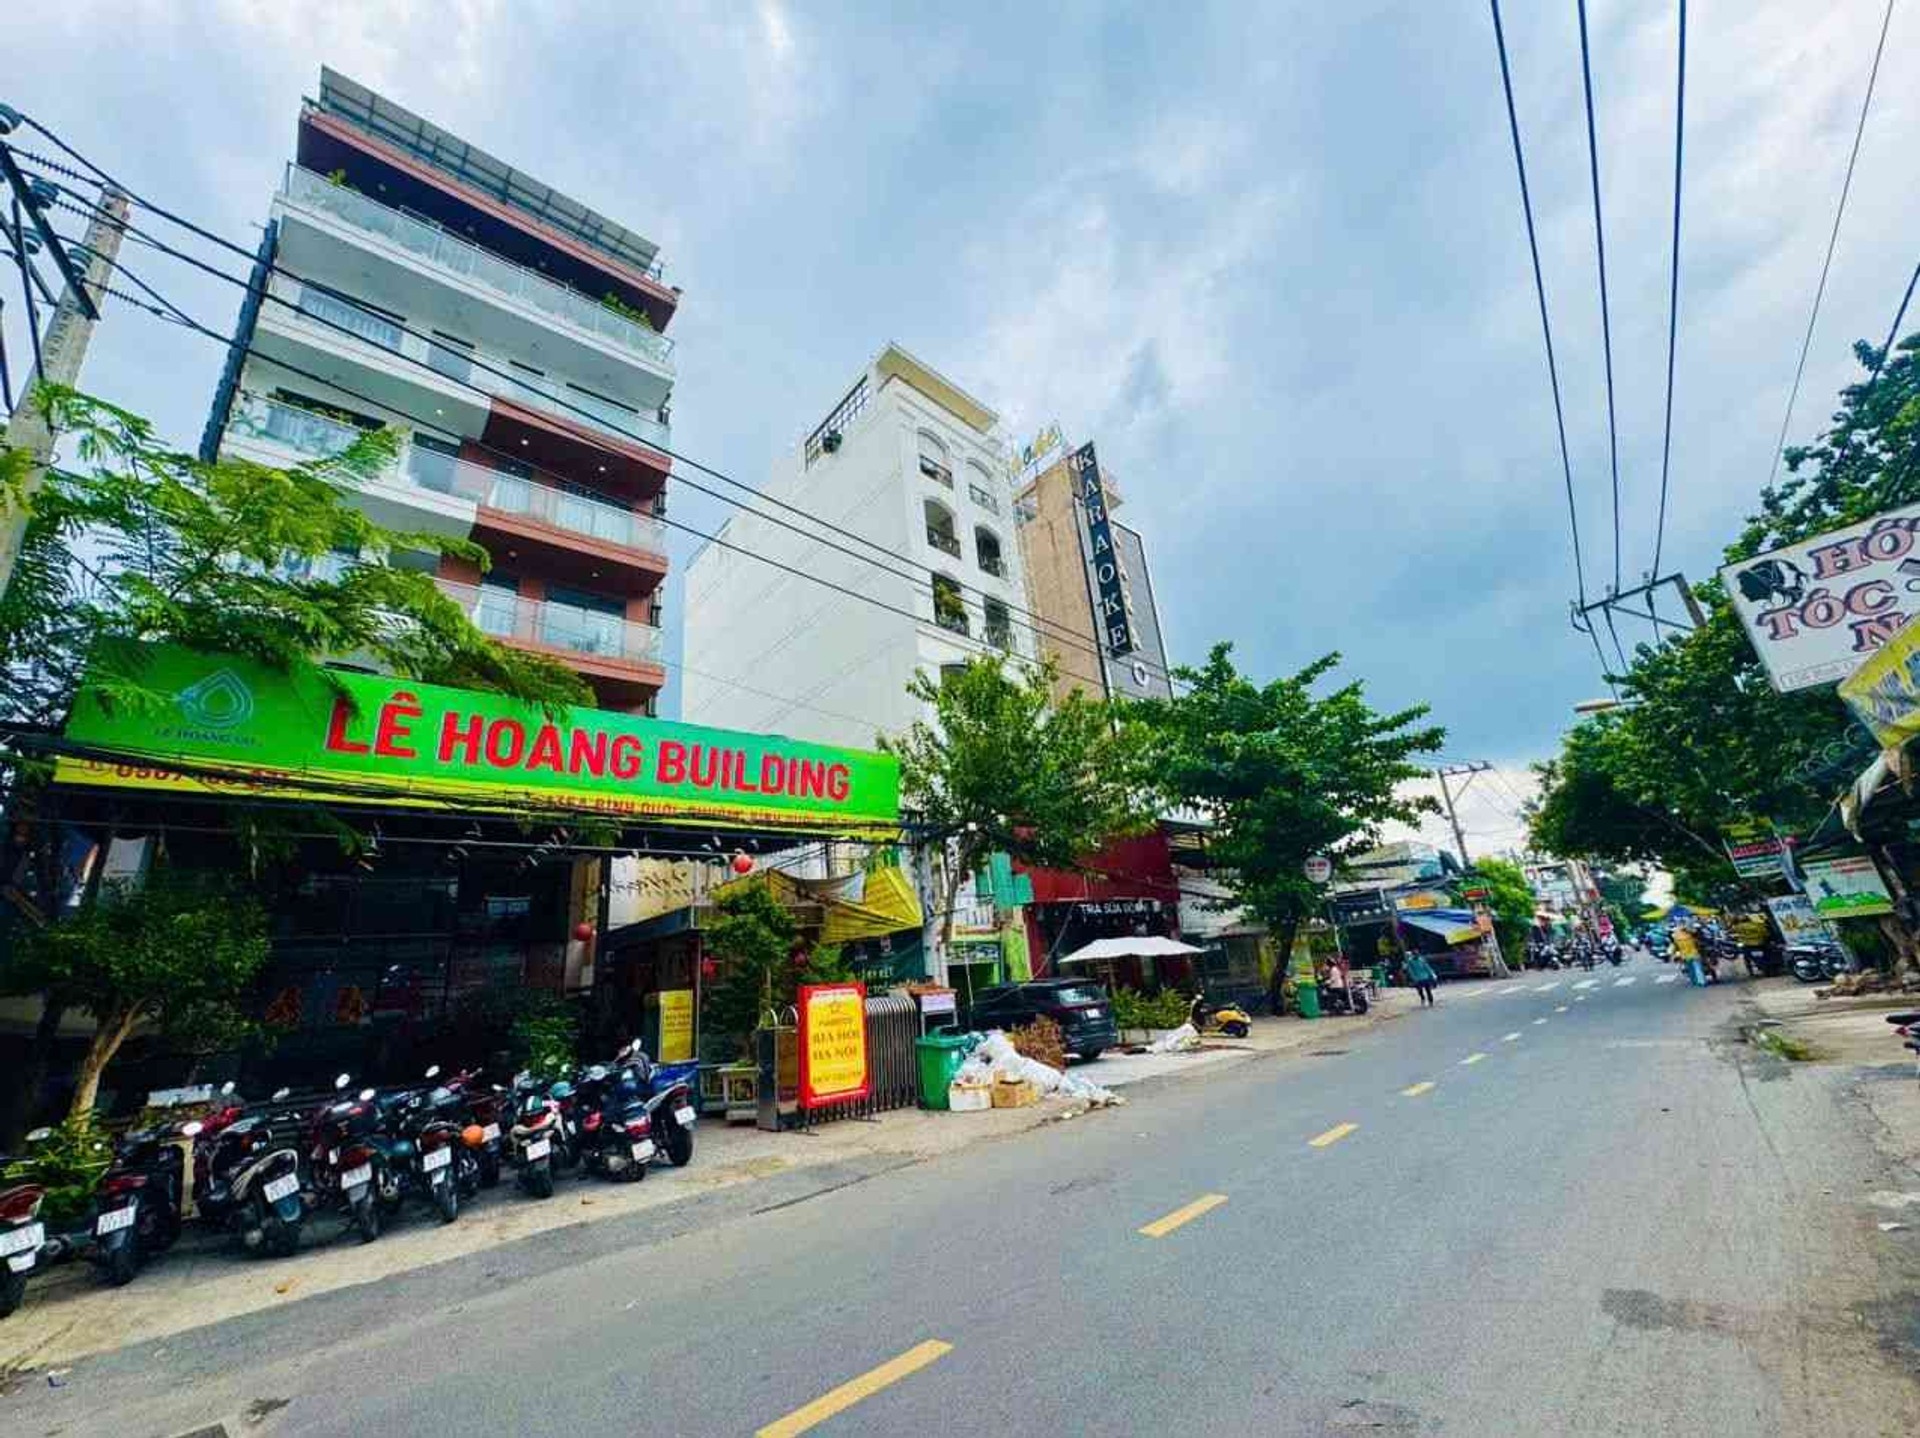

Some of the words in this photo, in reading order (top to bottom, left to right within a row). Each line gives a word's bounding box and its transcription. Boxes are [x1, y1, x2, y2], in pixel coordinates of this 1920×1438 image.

[1078, 449, 1128, 650] KARAOKE
[1808, 517, 1920, 581] HỚ
[1756, 579, 1899, 641] TÓC
[325, 691, 423, 758] LÊ
[436, 709, 644, 781] HOÀNG
[656, 739, 851, 802] BUILDING
